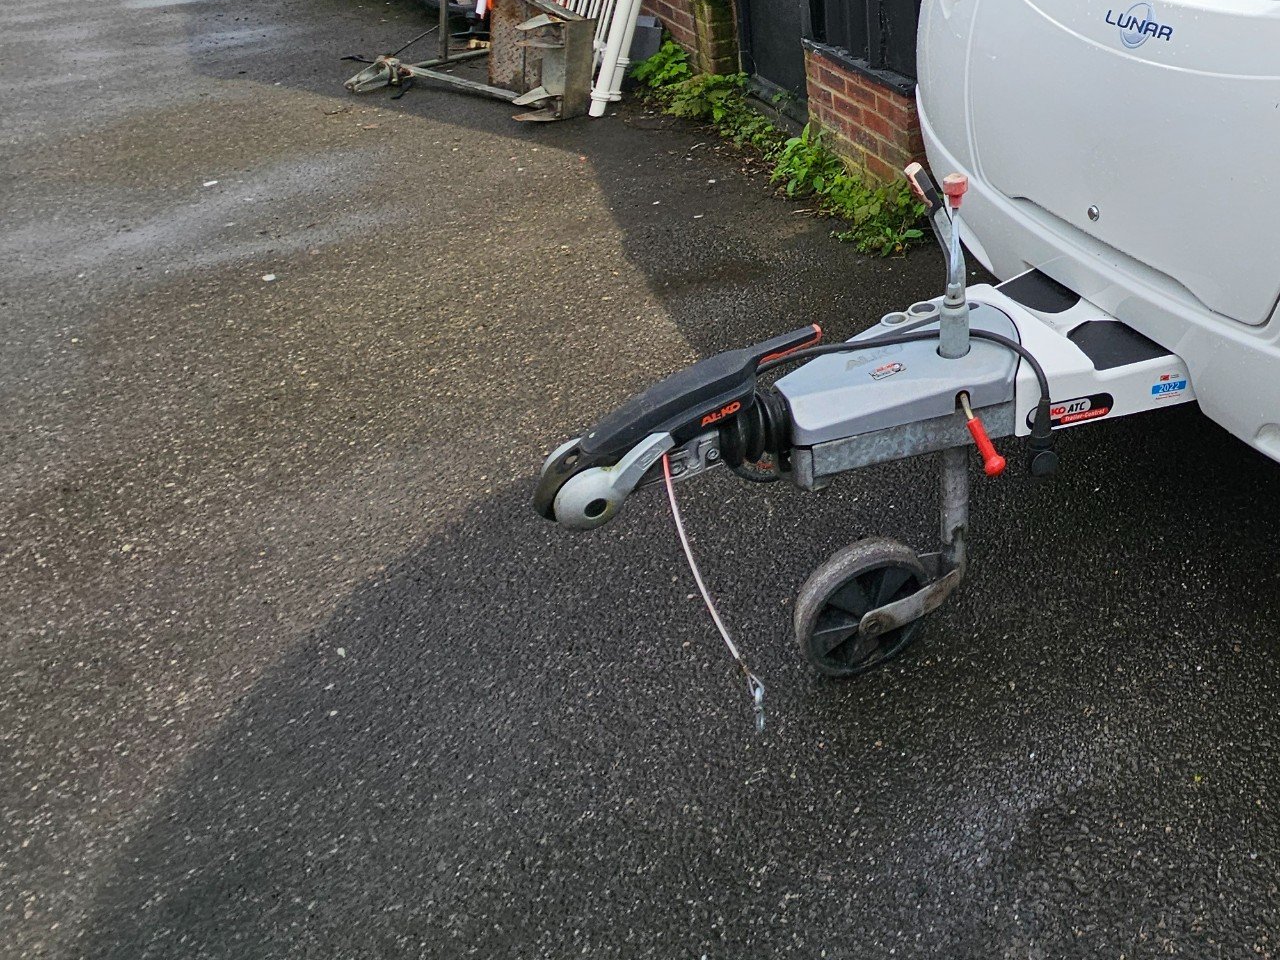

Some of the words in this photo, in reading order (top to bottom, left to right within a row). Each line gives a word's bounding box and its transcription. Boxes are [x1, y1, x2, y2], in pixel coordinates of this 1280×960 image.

[1105, 9, 1174, 42] LUNAR
[1158, 382, 1180, 393] 2022
[701, 401, 741, 427] AL-KO
[1050, 405, 1067, 416] KO
[1067, 401, 1087, 414] ATC
[1063, 408, 1106, 423] Trailer-Control
